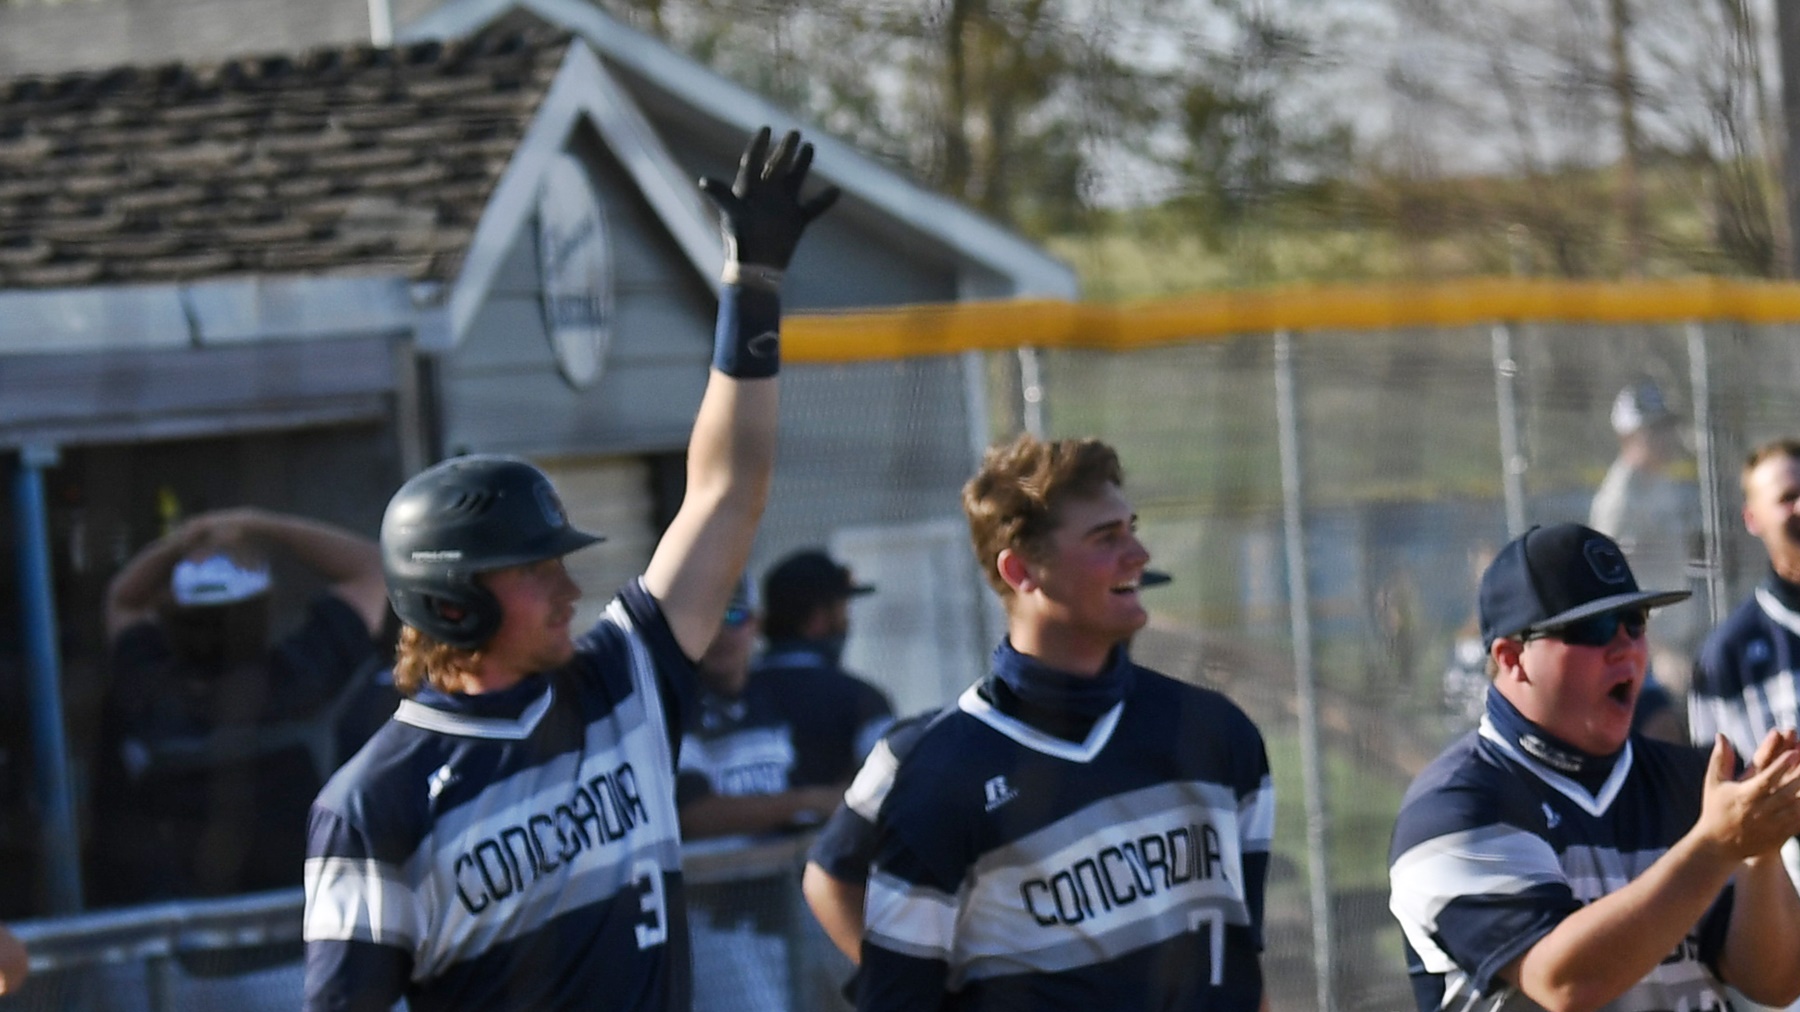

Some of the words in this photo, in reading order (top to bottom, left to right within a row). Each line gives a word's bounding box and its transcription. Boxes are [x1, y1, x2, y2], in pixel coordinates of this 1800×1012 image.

[452, 761, 649, 916] CONCORDIA
[1019, 823, 1229, 928] CONCORDIA
[632, 858, 669, 951] 3
[1187, 907, 1225, 987] 7
